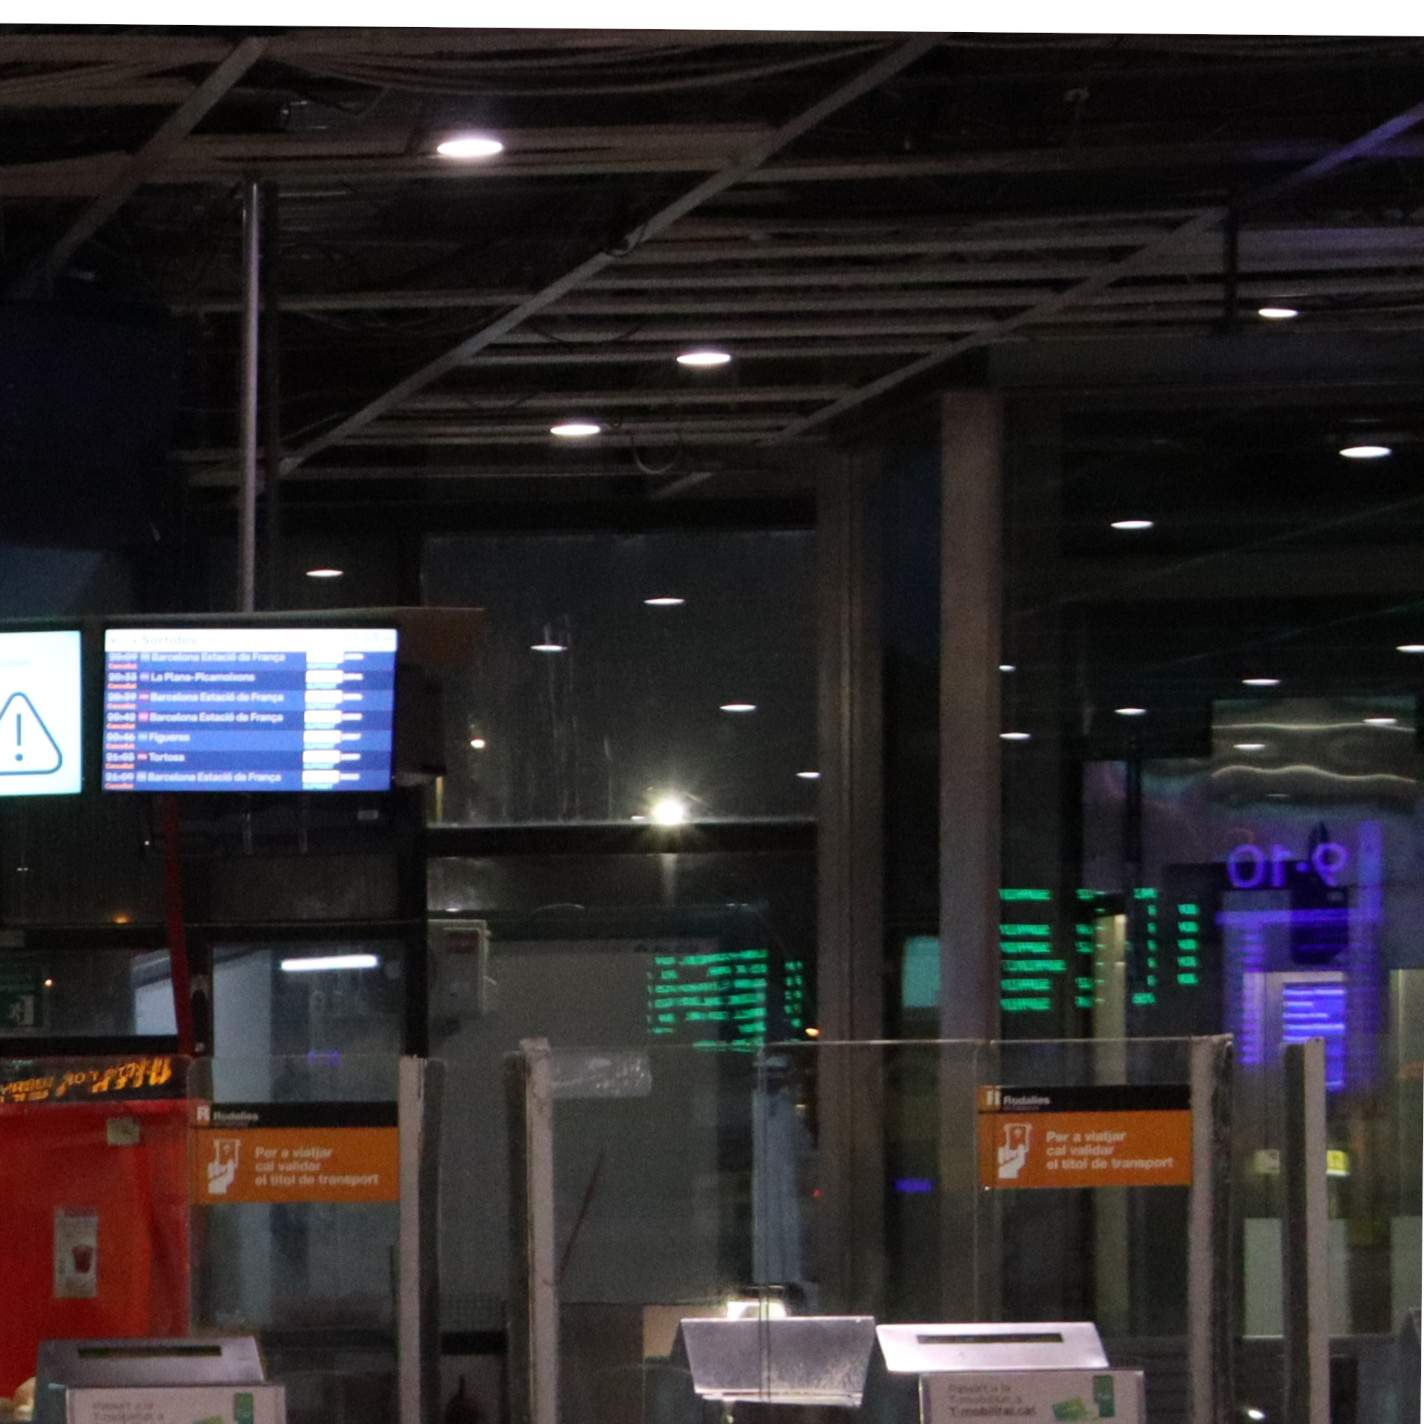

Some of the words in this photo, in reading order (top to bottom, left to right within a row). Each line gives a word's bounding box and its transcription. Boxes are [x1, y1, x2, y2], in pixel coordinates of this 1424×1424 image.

[151, 653, 200, 662] Barcelona
[201, 652, 236, 662] Estació
[238, 653, 251, 662] de
[252, 653, 286, 664] França
[151, 673, 163, 682] La
[150, 693, 198, 703] Barcelona
[200, 692, 235, 703] Estació
[237, 693, 250, 703] de
[251, 693, 284, 704] França
[150, 713, 198, 723] Barcelona
[199, 712, 235, 723] Estació
[236, 713, 249, 723] de
[250, 713, 284, 724] França
[148, 752, 186, 762] Tortosa
[148, 772, 196, 782] Barcelona
[197, 772, 233, 782] Estació
[234, 773, 247, 782] de
[248, 773, 282, 784] França
[1003, 1095, 1051, 1106] Rodalies
[213, 1111, 260, 1122] Rodalies
[1045, 1131, 1070, 1143] Per
[1072, 1133, 1082, 1143] a
[1084, 1131, 1128, 1145] viatjar
[255, 1147, 277, 1159] Per
[281, 1149, 290, 1159] a
[293, 1147, 334, 1160] viatjar
[1045, 1145, 1067, 1156] cal
[1069, 1144, 1115, 1156] validar
[255, 1160, 274, 1172] cal
[278, 1160, 322, 1172] validar
[1046, 1159, 1059, 1170] el
[1091, 1158, 1108, 1170] de
[1111, 1157, 1175, 1170] transport
[255, 1175, 267, 1186] el
[299, 1175, 316, 1186] de
[319, 1174, 380, 1187] transport
